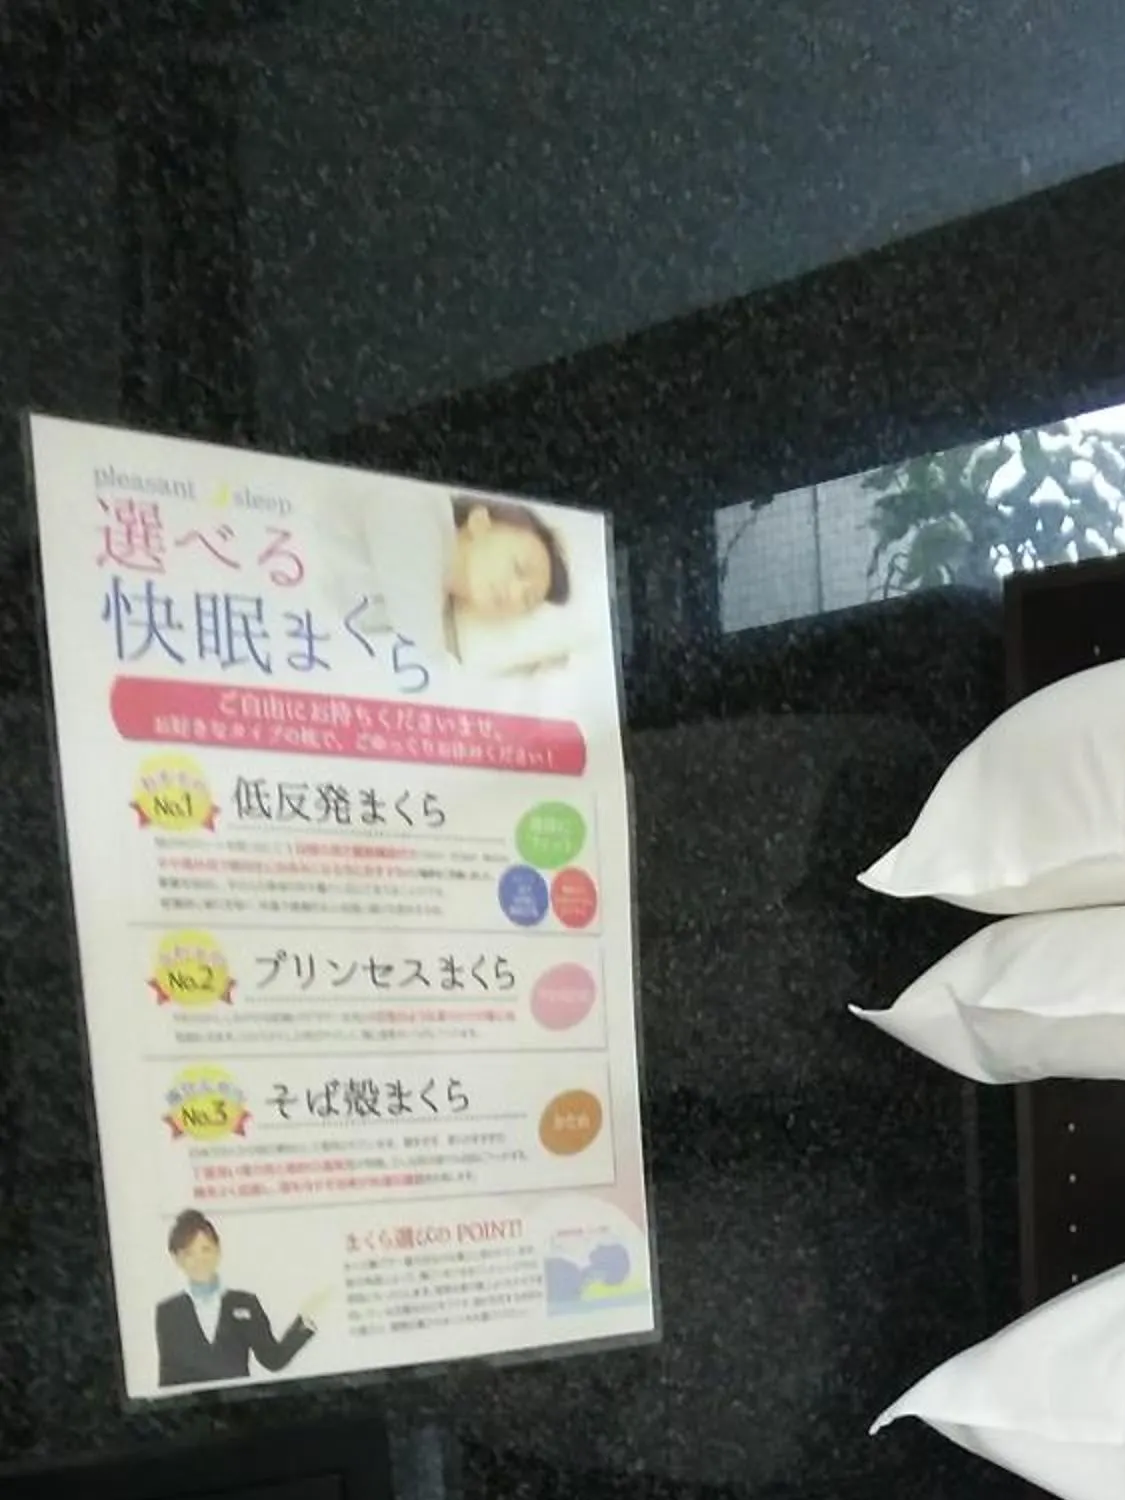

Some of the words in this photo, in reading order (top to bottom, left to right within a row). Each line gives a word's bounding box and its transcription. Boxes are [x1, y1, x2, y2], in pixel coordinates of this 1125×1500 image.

[93, 465, 197, 501] pleasant
[233, 486, 293, 516] sleep
[96, 495, 305, 587] 選べる
[101, 575, 429, 693] 快眠まくら
[232, 775, 446, 828] 低反発まくら
[255, 948, 516, 991] プリンセスまくら
[264, 1077, 469, 1120] そば殻まくら
